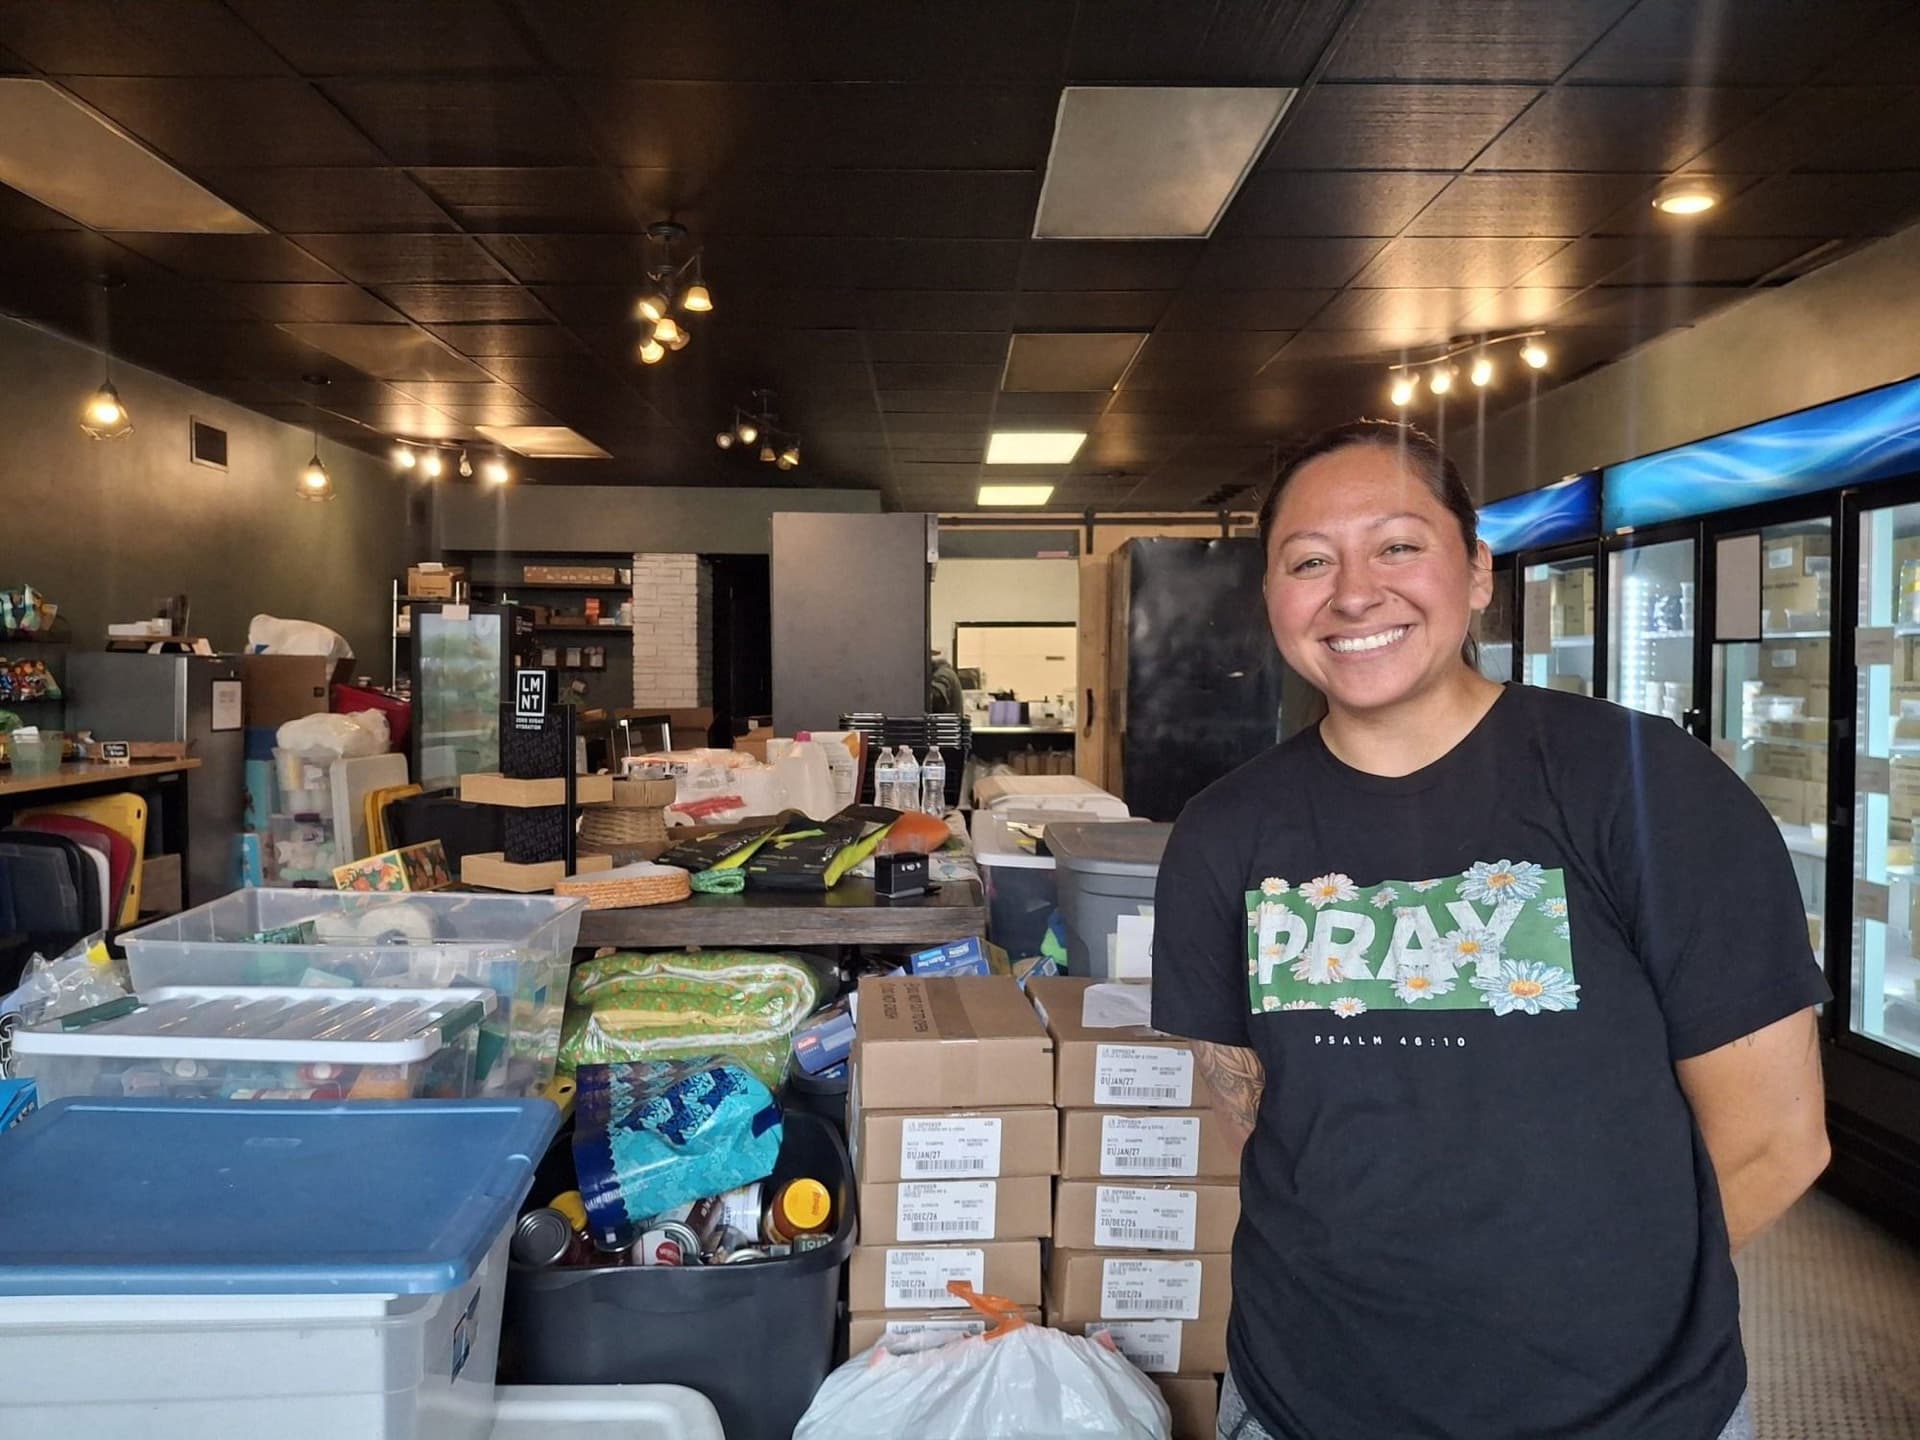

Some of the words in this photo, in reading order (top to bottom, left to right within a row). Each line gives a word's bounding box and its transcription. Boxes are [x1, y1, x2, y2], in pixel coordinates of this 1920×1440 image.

[522, 676, 541, 693] LM
[521, 694, 540, 711] NT
[1257, 898, 1526, 985] PRAY
[1314, 1034, 1382, 1046] PSALM
[1399, 1035, 1466, 1047] 46:10
